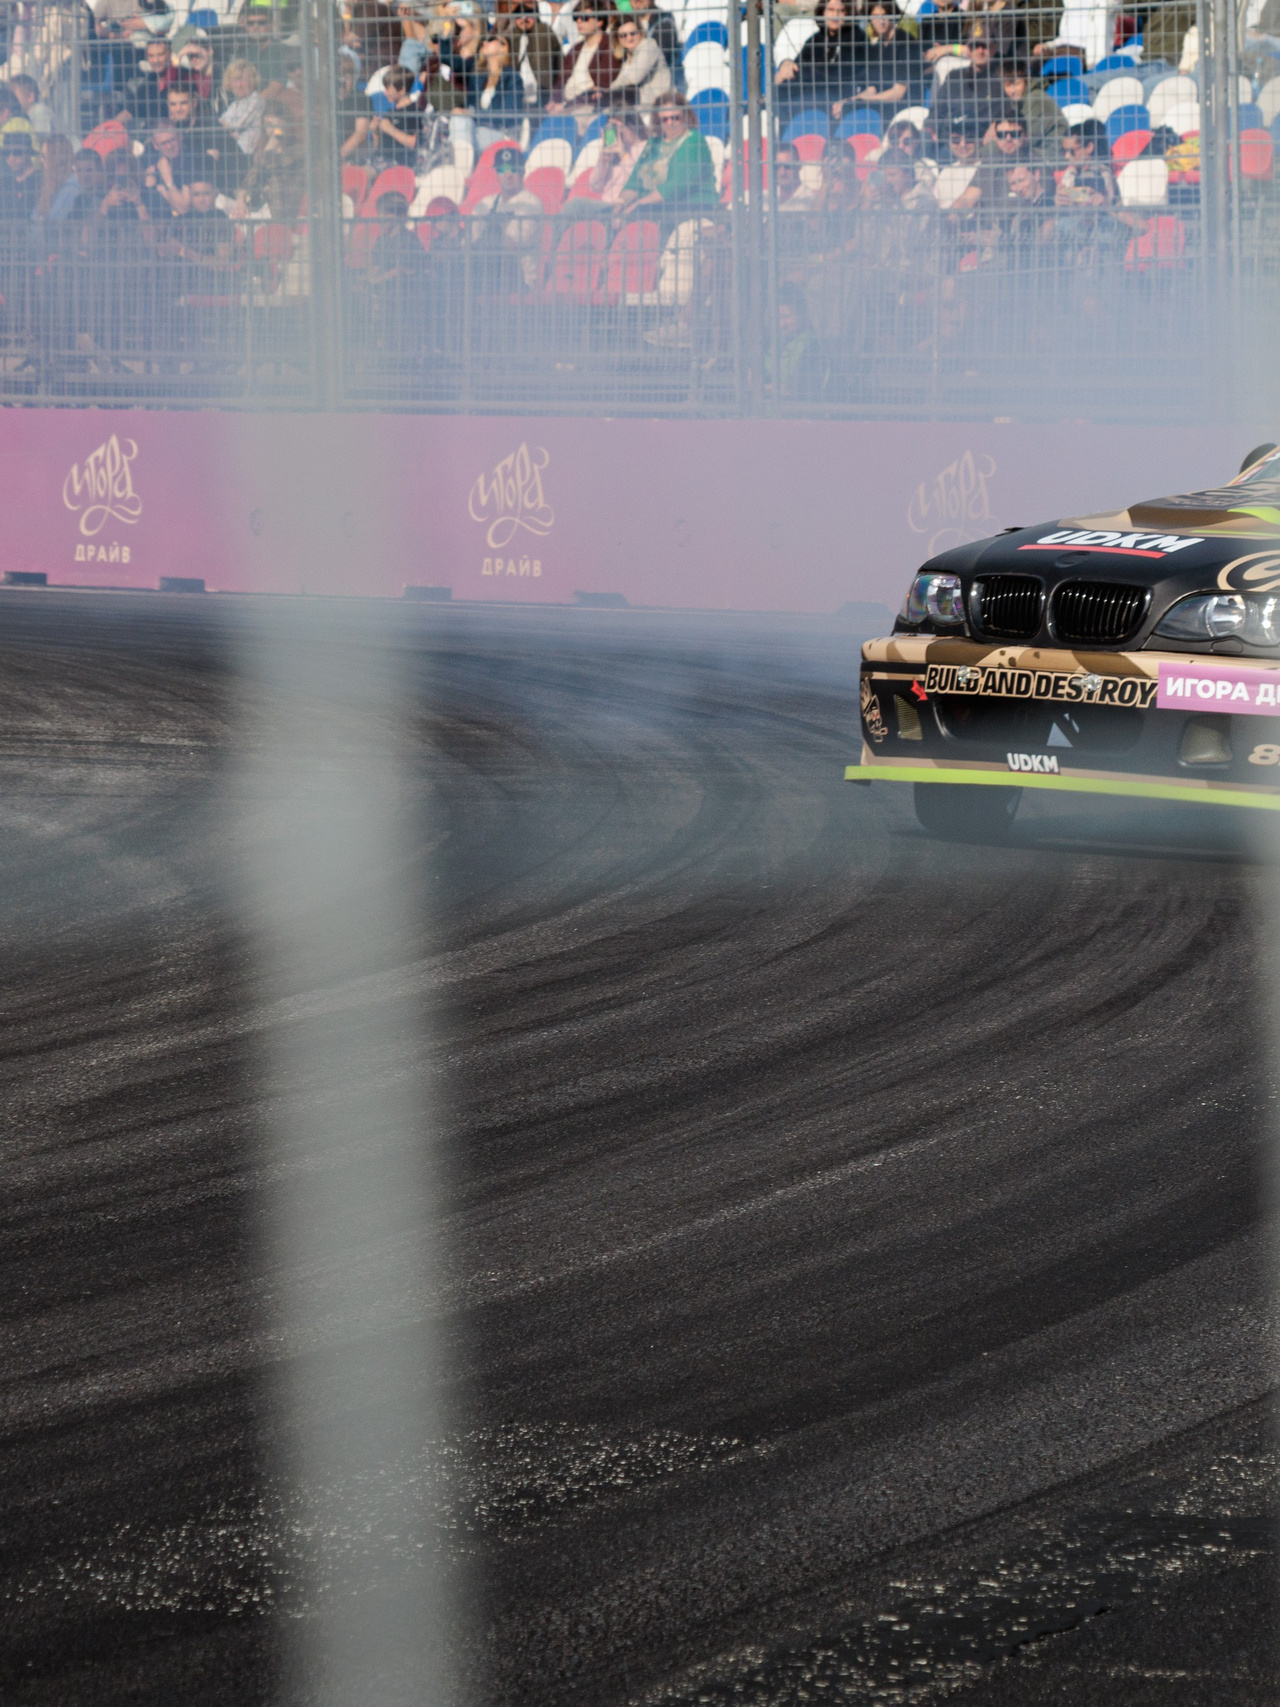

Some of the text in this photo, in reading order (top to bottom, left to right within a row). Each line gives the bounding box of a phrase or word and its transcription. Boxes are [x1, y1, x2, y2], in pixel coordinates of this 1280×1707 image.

[1036, 530, 1206, 553] UDKM
[74, 542, 132, 564] ДРАЙВ
[481, 555, 543, 577] ДРАЙВ
[925, 665, 982, 695] BUILD
[980, 668, 1034, 698] AND
[1166, 677, 1250, 702] ИГОРА
[1006, 752, 1060, 773] UDKM
